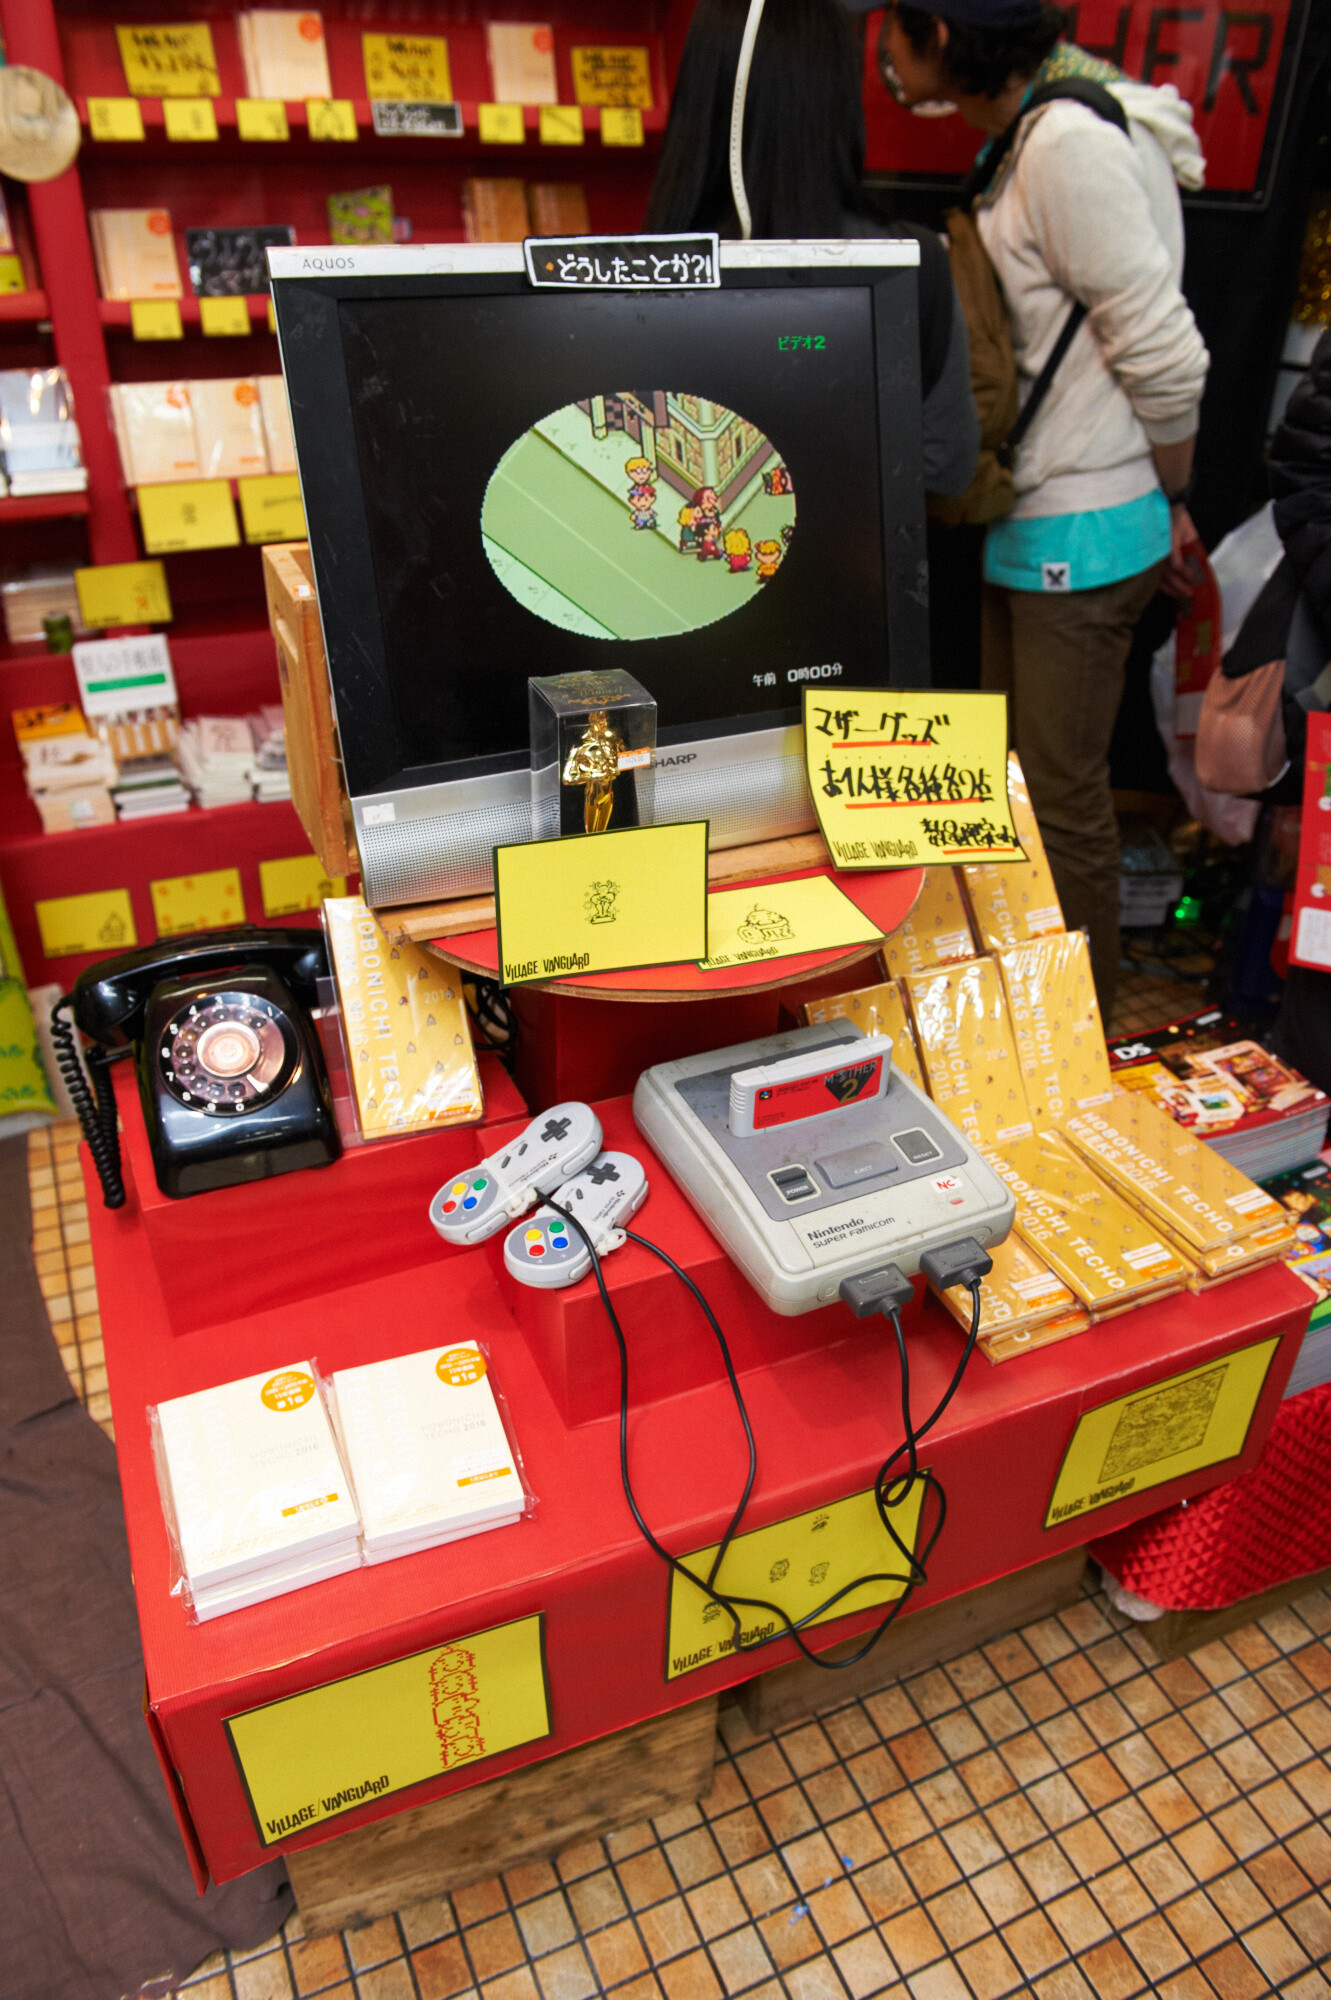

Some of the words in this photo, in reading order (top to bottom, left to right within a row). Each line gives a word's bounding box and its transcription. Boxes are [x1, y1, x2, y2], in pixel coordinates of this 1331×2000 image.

[303, 257, 355, 271] AQUOS
[778, 335, 826, 351] ビデオ2
[752, 672, 777, 687] 午前
[787, 662, 843, 682] 0時00分
[813, 707, 950, 744] マザーグッズ
[832, 840, 869, 862] VILLAGE
[870, 839, 918, 860] VANGUARD
[505, 959, 539, 981] VILLAGE
[543, 952, 590, 972] VANGUARD
[840, 1078, 859, 1103] 2
[931, 1058, 955, 1102] 2016
[913, 1151, 933, 1160] RESET
[1066, 1117, 1121, 1161] WEEKS
[1119, 1159, 1161, 1192] 2016
[854, 1165, 873, 1175] EJECT
[1080, 1111, 1175, 1183] HOBONICHI
[1174, 1183, 1234, 1233] TECHO
[786, 1184, 809, 1195] POWER
[936, 1179, 956, 1190] NC
[807, 1217, 865, 1241] Nintendo
[983, 1151, 1072, 1235] HOBONICHI
[1069, 1235, 1127, 1290] TECHO
[1014, 1208, 1054, 1242] 2016
[812, 1233, 848, 1249] SUPER
[672, 1645, 714, 1671] VILLAGE
[266, 1804, 317, 1835] VILLAGE
[321, 1775, 390, 1812] VANGUARD
